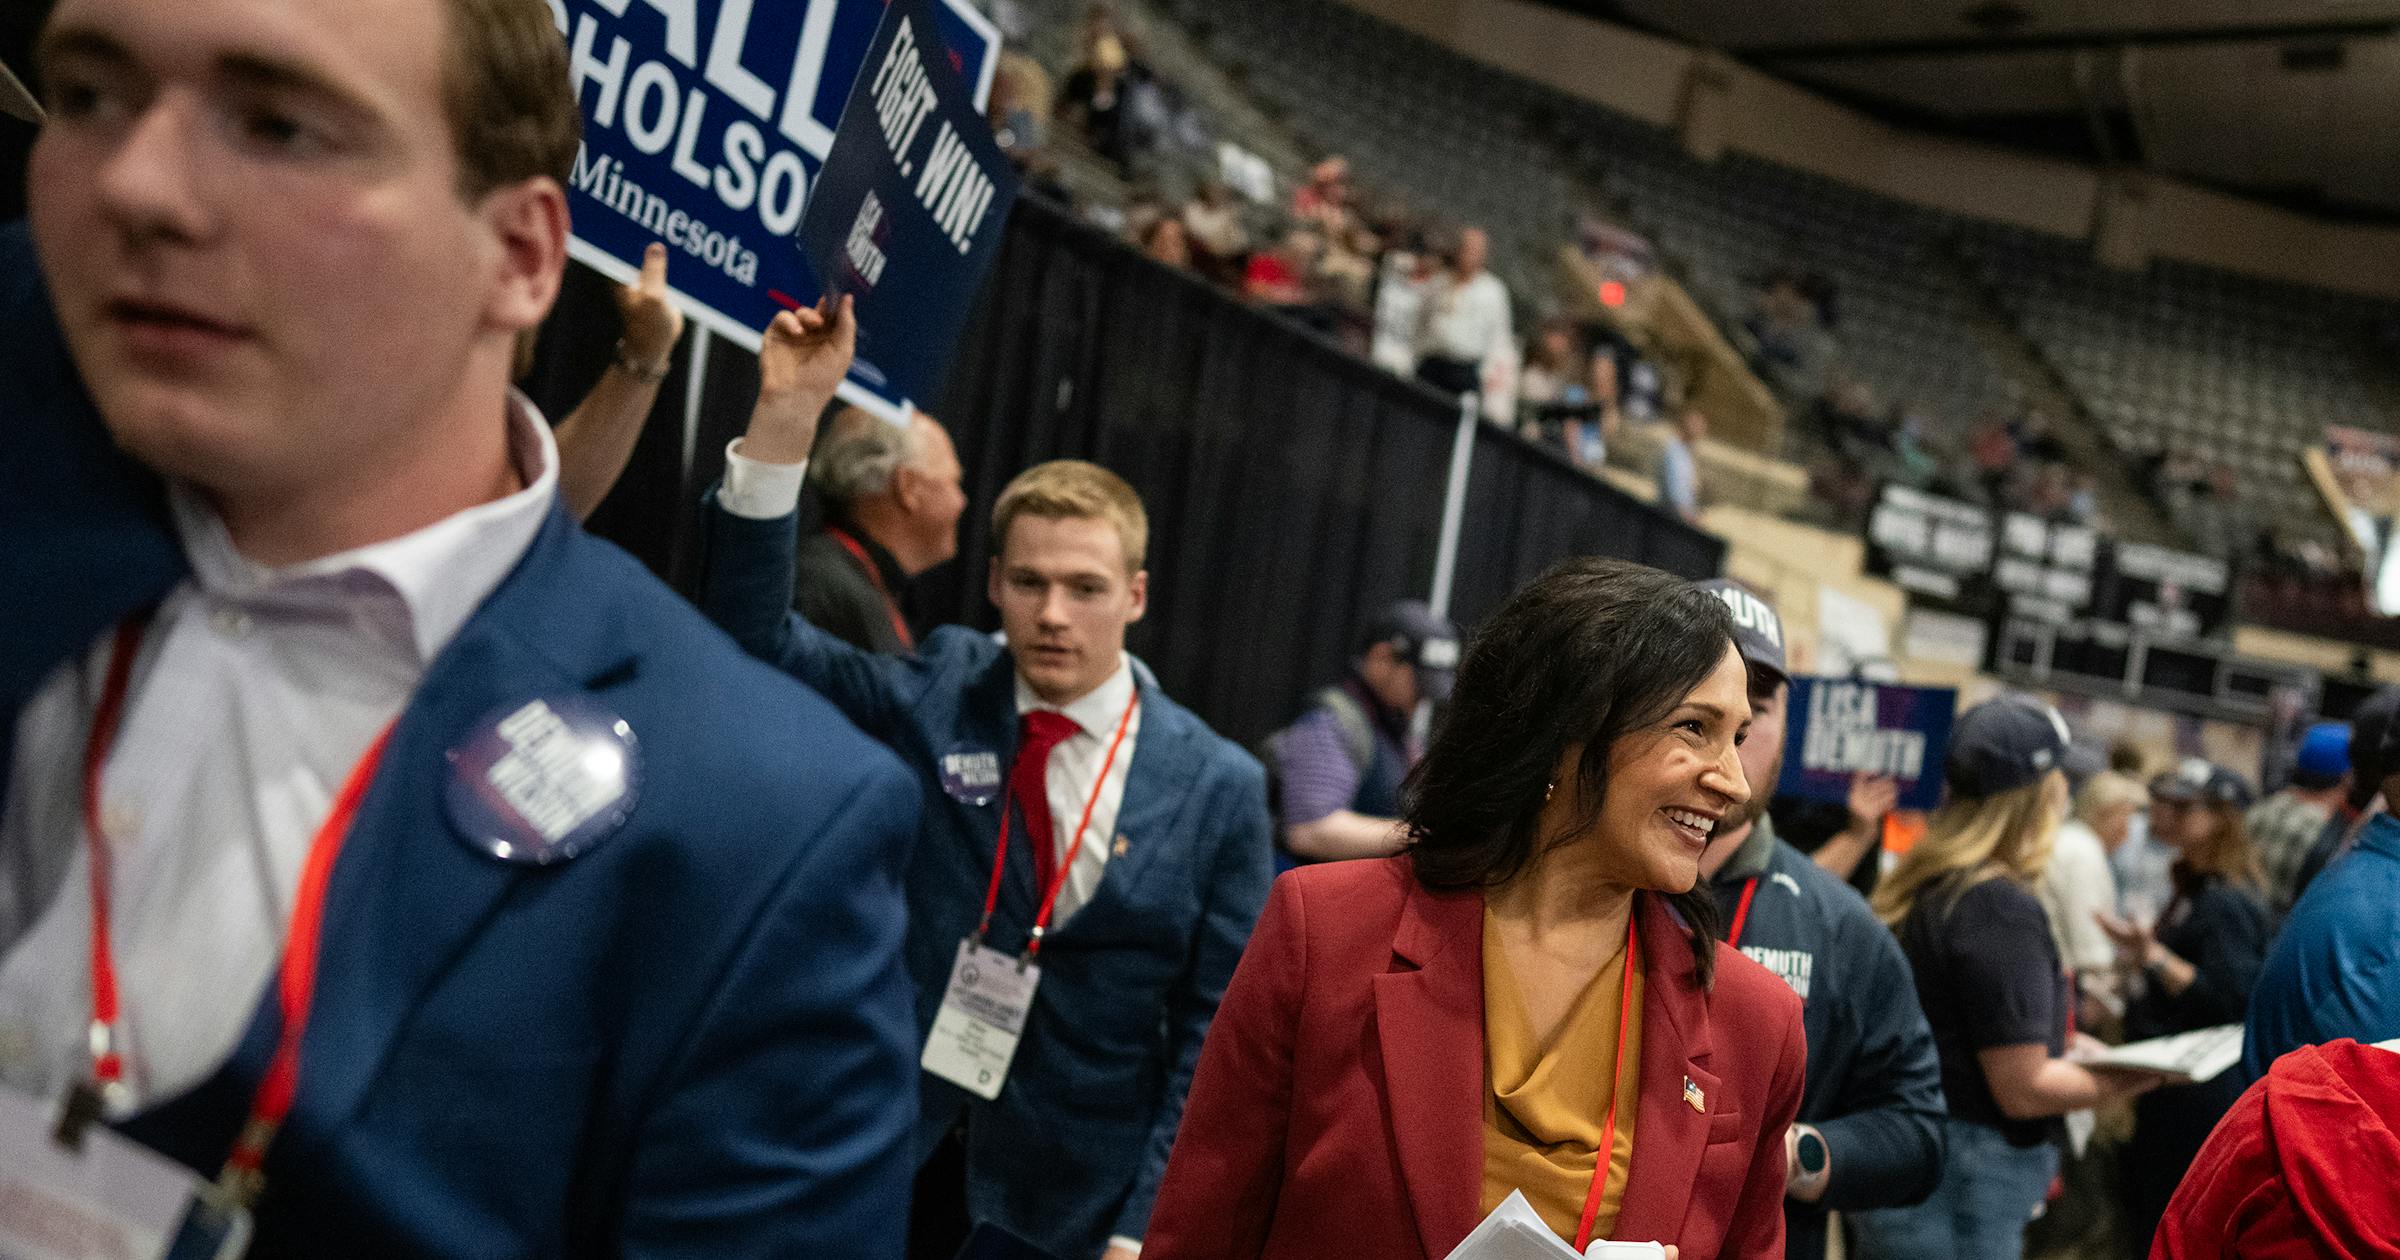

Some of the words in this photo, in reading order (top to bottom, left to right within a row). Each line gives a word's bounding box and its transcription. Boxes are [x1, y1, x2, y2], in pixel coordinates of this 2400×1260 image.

[546, 0, 818, 240] HOLSO
[870, 14, 939, 178] FIGHT.
[914, 119, 997, 256] WIN!
[569, 139, 759, 288] Minnesota
[1802, 722, 1927, 780] DEMUTH
[1808, 680, 1877, 727] LISA
